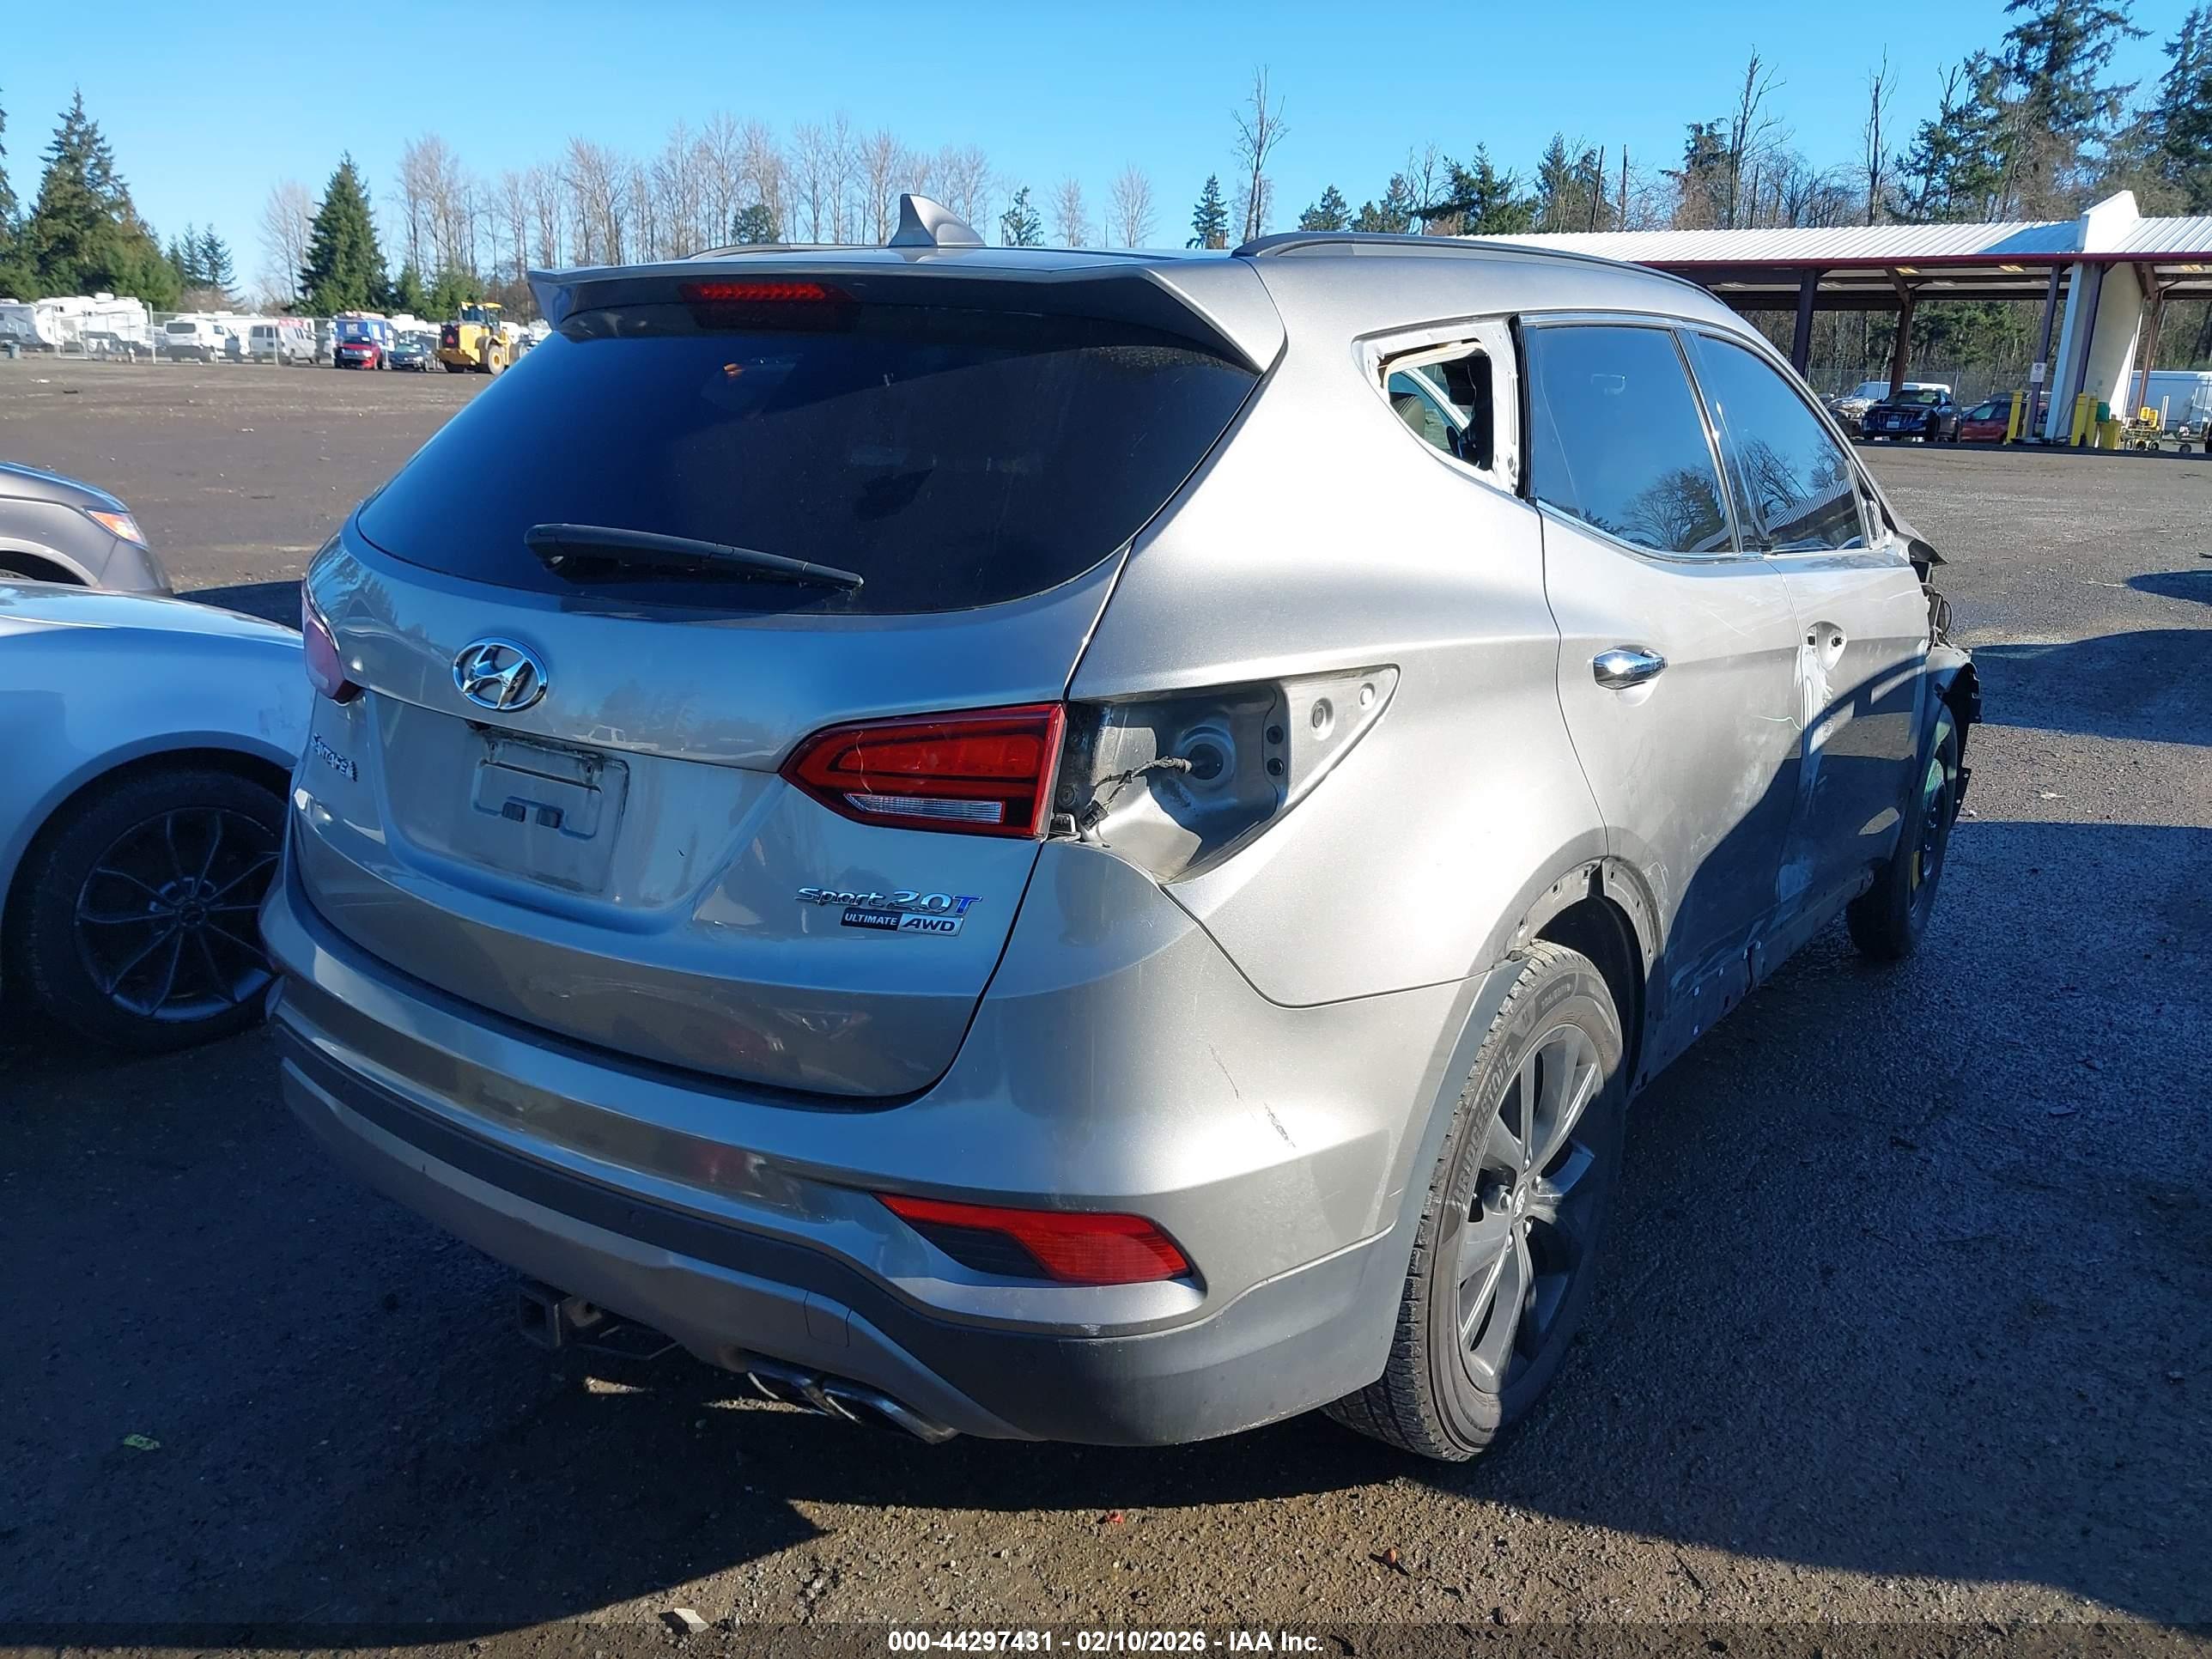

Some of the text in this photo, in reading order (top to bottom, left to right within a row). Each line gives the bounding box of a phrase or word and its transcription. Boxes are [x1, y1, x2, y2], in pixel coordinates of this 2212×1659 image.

[795, 886, 885, 909] Sport
[844, 913, 956, 932] ULTIMATE AWD
